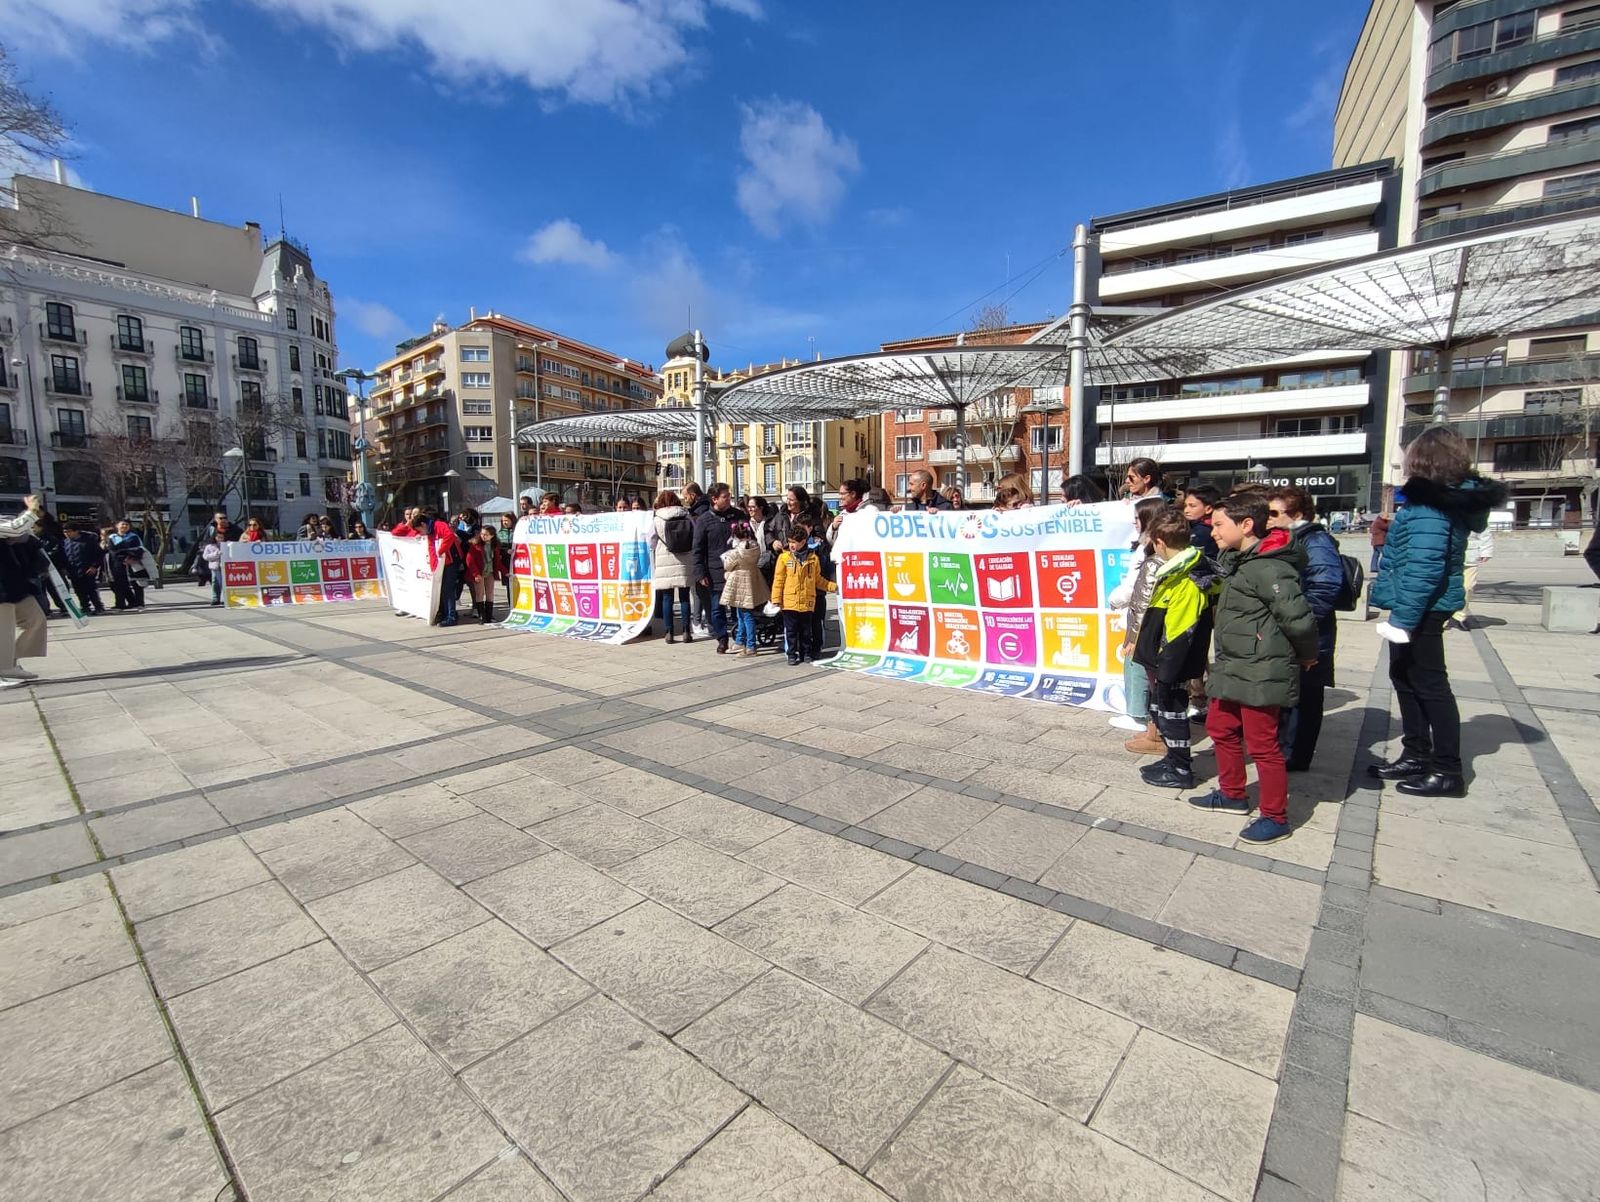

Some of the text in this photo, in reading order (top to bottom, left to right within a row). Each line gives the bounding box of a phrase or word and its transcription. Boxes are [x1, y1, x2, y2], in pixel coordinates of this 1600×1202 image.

[1295, 476, 1336, 487] SIGLO
[874, 512, 999, 540] OBJETIVOS
[1000, 518, 1103, 538] SOSTENIBLE
[251, 541, 334, 555] OBJETIVOS
[932, 556, 939, 568] 3
[978, 558, 985, 571] 4
[1041, 554, 1048, 569] 5
[1107, 553, 1116, 567] 6
[892, 608, 898, 620] 8
[937, 611, 943, 623] 9
[984, 616, 995, 628] 10
[1044, 616, 1054, 630] 11
[1043, 677, 1055, 689] 17
